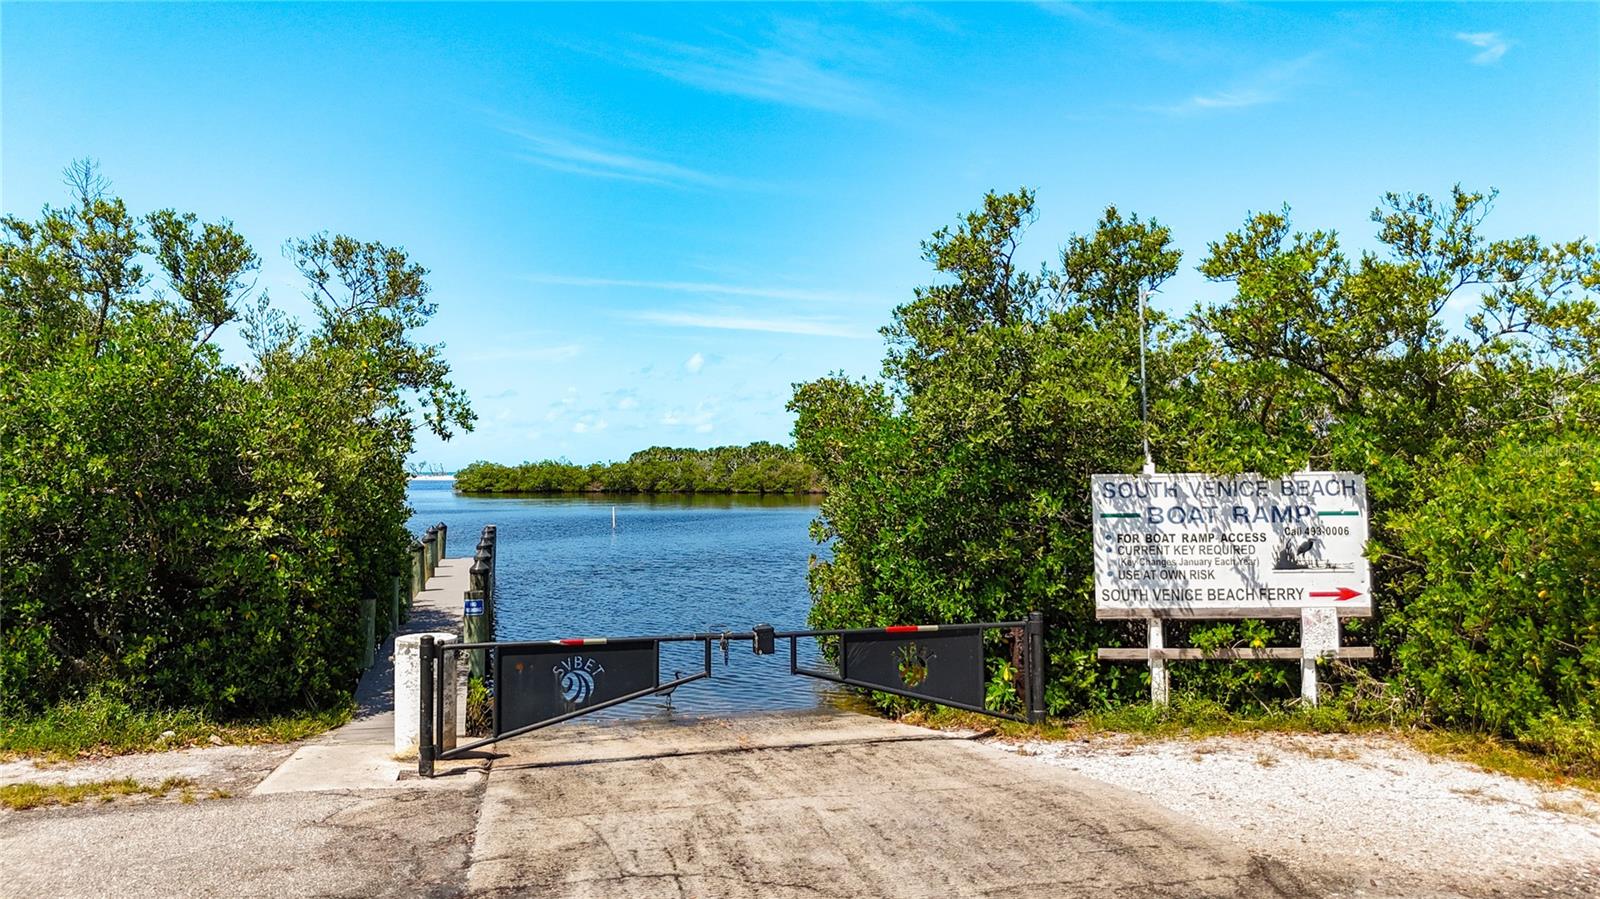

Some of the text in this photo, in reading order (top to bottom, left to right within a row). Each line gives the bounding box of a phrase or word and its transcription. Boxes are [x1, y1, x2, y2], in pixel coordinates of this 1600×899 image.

[1102, 479, 1356, 499] SOUTH VENICE BEACH
[1146, 504, 1311, 525] BOAT RAMP
[1284, 526, 1350, 536] Call 493-0006
[1117, 532, 1267, 544] FOR BOAT RAMP ACCESS
[1117, 544, 1256, 556] CURRENT KEY REQUIRED
[1139, 557, 1177, 568] Changes
[1178, 557, 1212, 568] January
[1214, 557, 1237, 566] Each
[1239, 556, 1260, 567] Year)
[1118, 569, 1216, 580] USE AT OWN RISK
[1101, 587, 1305, 601] SOUTH VENICE BEACH FERRY
[552, 655, 606, 676] SVBET
